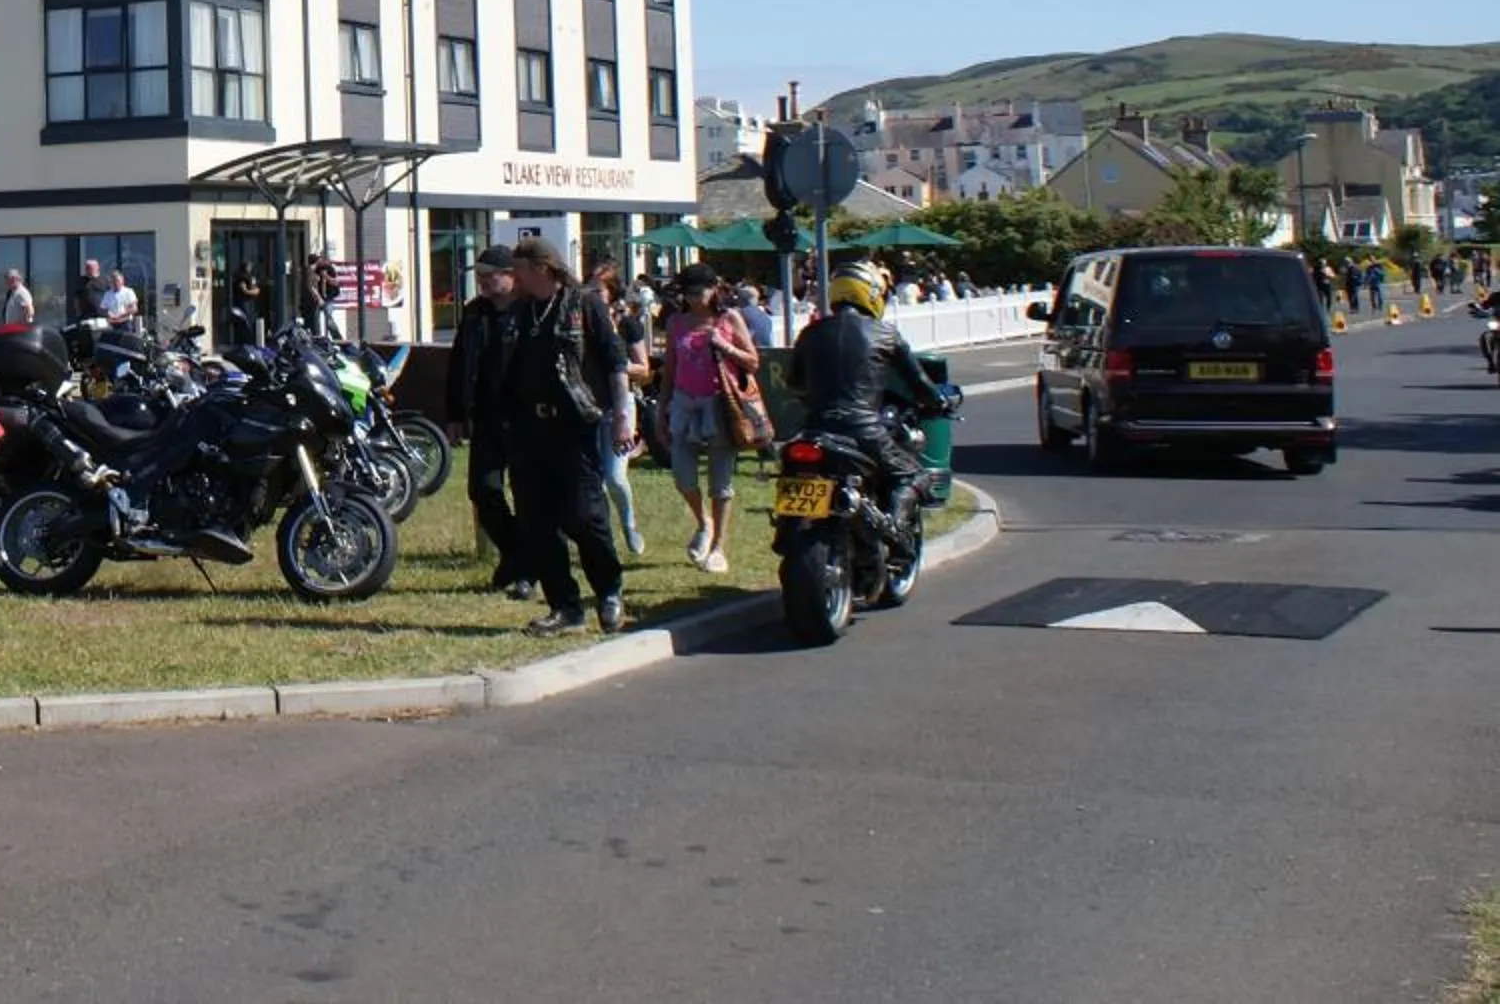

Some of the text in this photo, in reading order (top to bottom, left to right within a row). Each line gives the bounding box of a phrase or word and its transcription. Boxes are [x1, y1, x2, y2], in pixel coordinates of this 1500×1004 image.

[514, 164, 635, 189] LAKE VIEW RESTAURANT
[784, 497, 820, 513] ZZY
